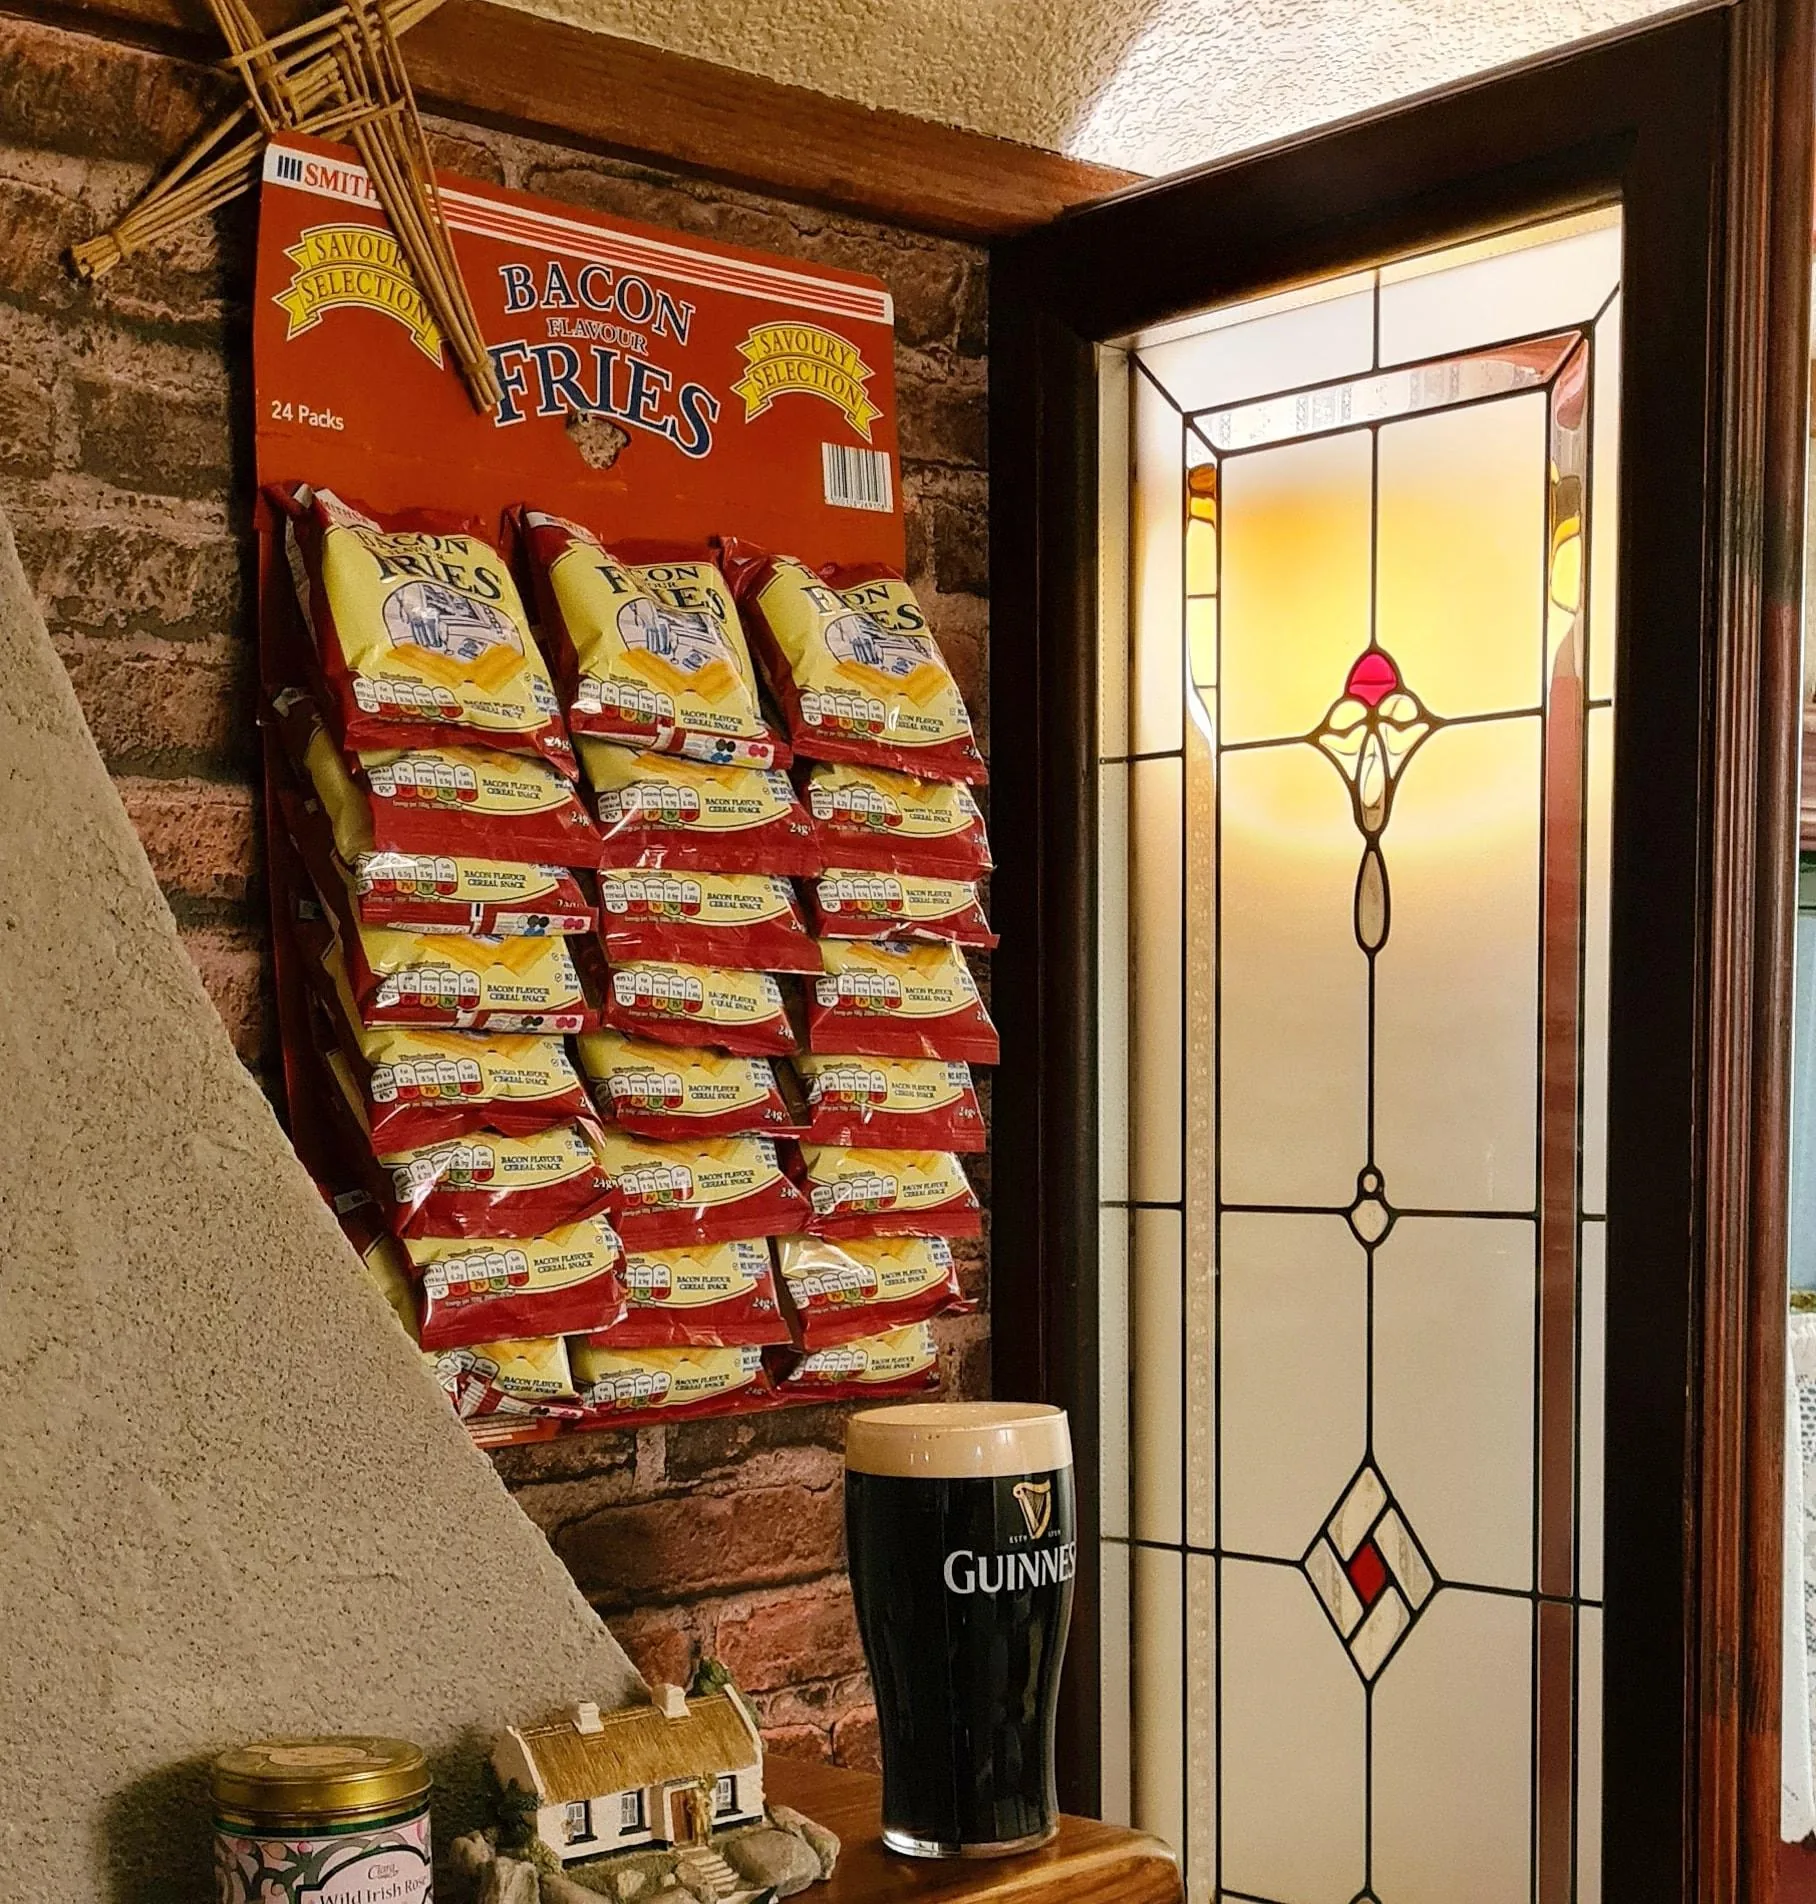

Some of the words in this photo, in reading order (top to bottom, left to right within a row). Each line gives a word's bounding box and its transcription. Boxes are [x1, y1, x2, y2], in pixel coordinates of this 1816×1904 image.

[305, 162, 378, 200] SMITH
[314, 233, 414, 277] SAVOUR
[302, 270, 430, 325] SELECTION
[499, 261, 696, 346] BACON
[547, 317, 654, 356] FLAVOUR
[760, 330, 856, 366] SAVOURY
[752, 362, 867, 407] SELECTION
[487, 340, 721, 459] FRIES
[272, 400, 293, 421] 24
[299, 404, 344, 431] Packs
[680, 709, 707, 718] BACON
[710, 713, 743, 726] FLAVOUR
[683, 717, 712, 726] CEREAL
[714, 721, 738, 732] SNACK
[482, 779, 509, 788] BACON
[511, 782, 542, 793] FLAVOUR
[487, 787, 515, 796] CEREAL
[518, 791, 540, 800] SNACK
[705, 798, 730, 806] BACON
[738, 806, 761, 814] SNACK
[790, 823, 809, 836] 24g
[494, 872, 526, 881] FLAVOUR
[468, 879, 498, 887] CEREAL
[501, 881, 525, 889] SNACK
[707, 893, 732, 901] BACON
[734, 894, 764, 903] FLAVOUR
[710, 901, 737, 909] CEREAL
[739, 903, 762, 911] SNACK
[488, 985, 514, 993] BACON
[516, 986, 549, 995] FLAVOUR
[490, 993, 520, 1001] CEREAL
[522, 995, 546, 1003] SNACK
[488, 1069, 516, 1077] BACON
[518, 1070, 550, 1079] FLAVOUR
[493, 1076, 523, 1084] CEREAL
[525, 1078, 549, 1086] SNACK
[764, 1109, 783, 1122] 24g
[501, 1156, 528, 1164] BACON
[698, 1174, 722, 1182] BACON
[725, 1169, 754, 1178] FLAVOUR
[702, 1180, 727, 1188] CEREAL
[730, 1177, 753, 1185] SNACK
[534, 1257, 559, 1266] BACON
[562, 1252, 594, 1262] FLAVOUR
[538, 1265, 567, 1274] CEREAL
[569, 1260, 592, 1269] SNACK
[753, 1298, 770, 1311] 24g
[943, 1541, 1076, 1594] GUINNES
[366, 1882, 401, 1903] Irish
